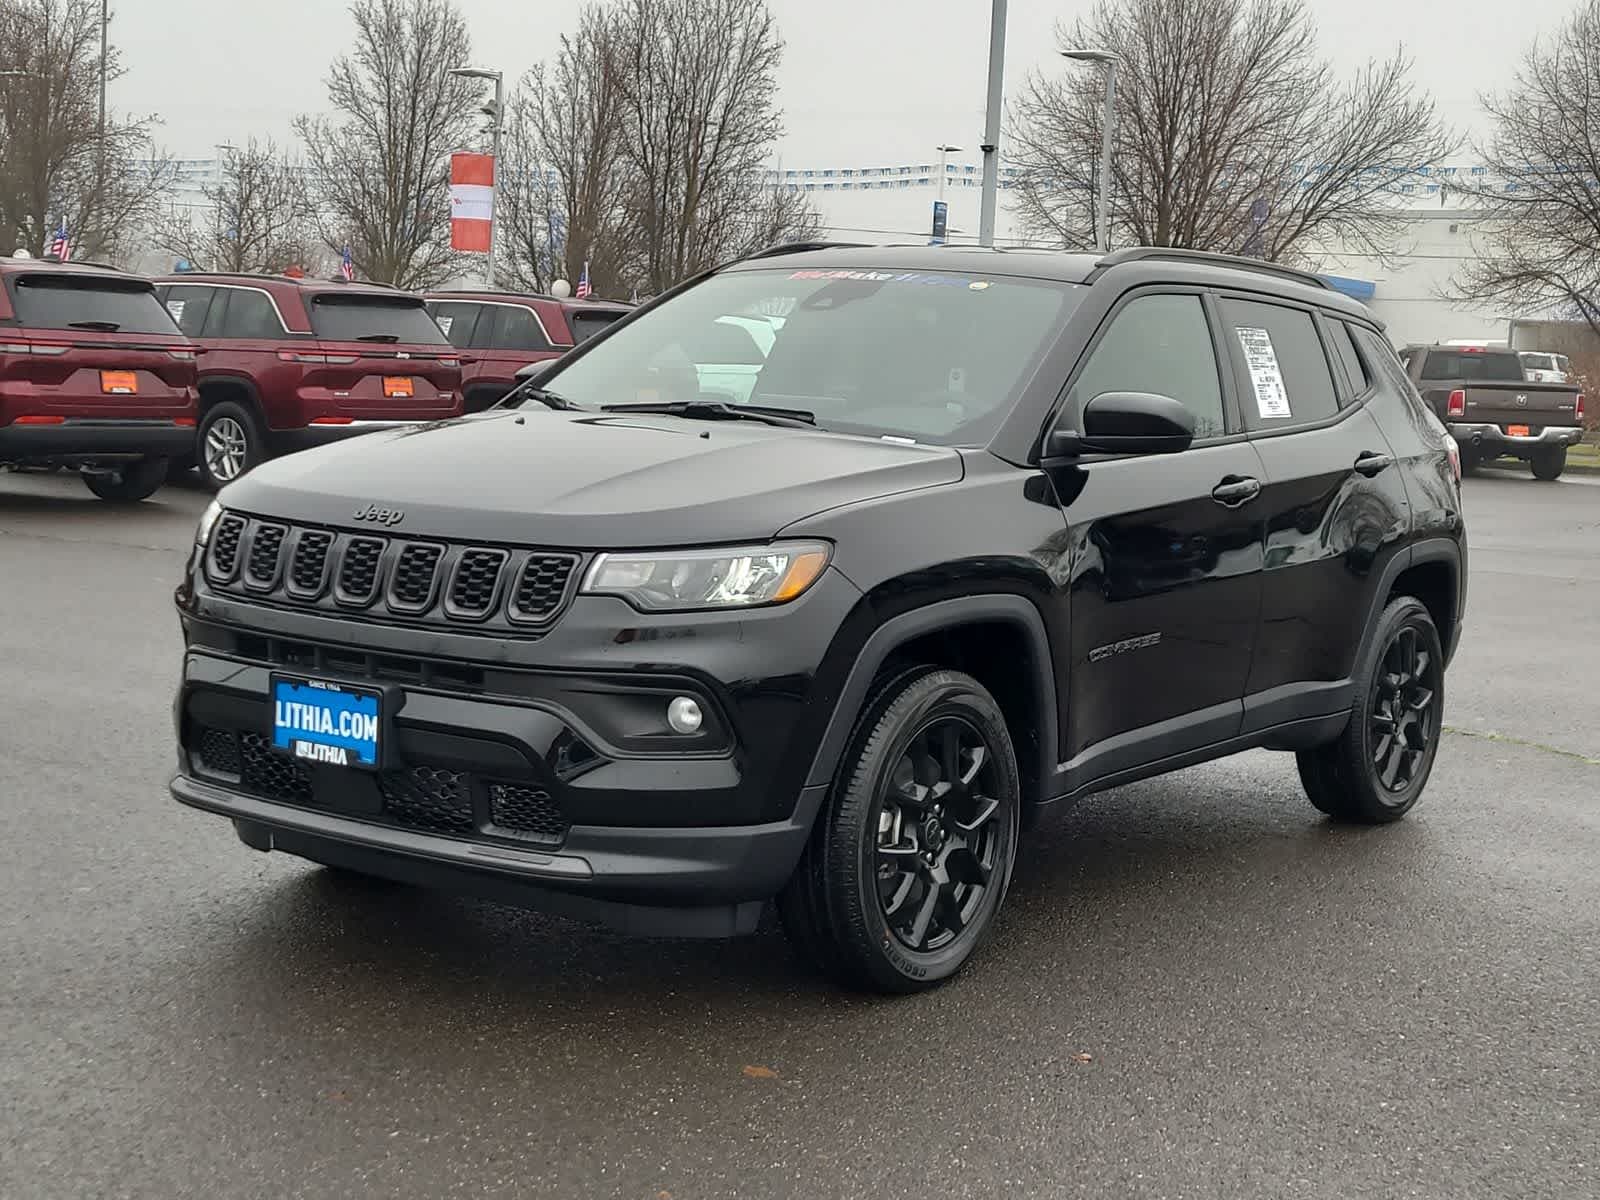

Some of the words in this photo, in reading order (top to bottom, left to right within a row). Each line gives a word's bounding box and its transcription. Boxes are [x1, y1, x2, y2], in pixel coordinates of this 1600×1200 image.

[352, 503, 405, 527] Jeep
[275, 700, 378, 742] LITHIA.COM
[307, 741, 347, 765] LITHIA
